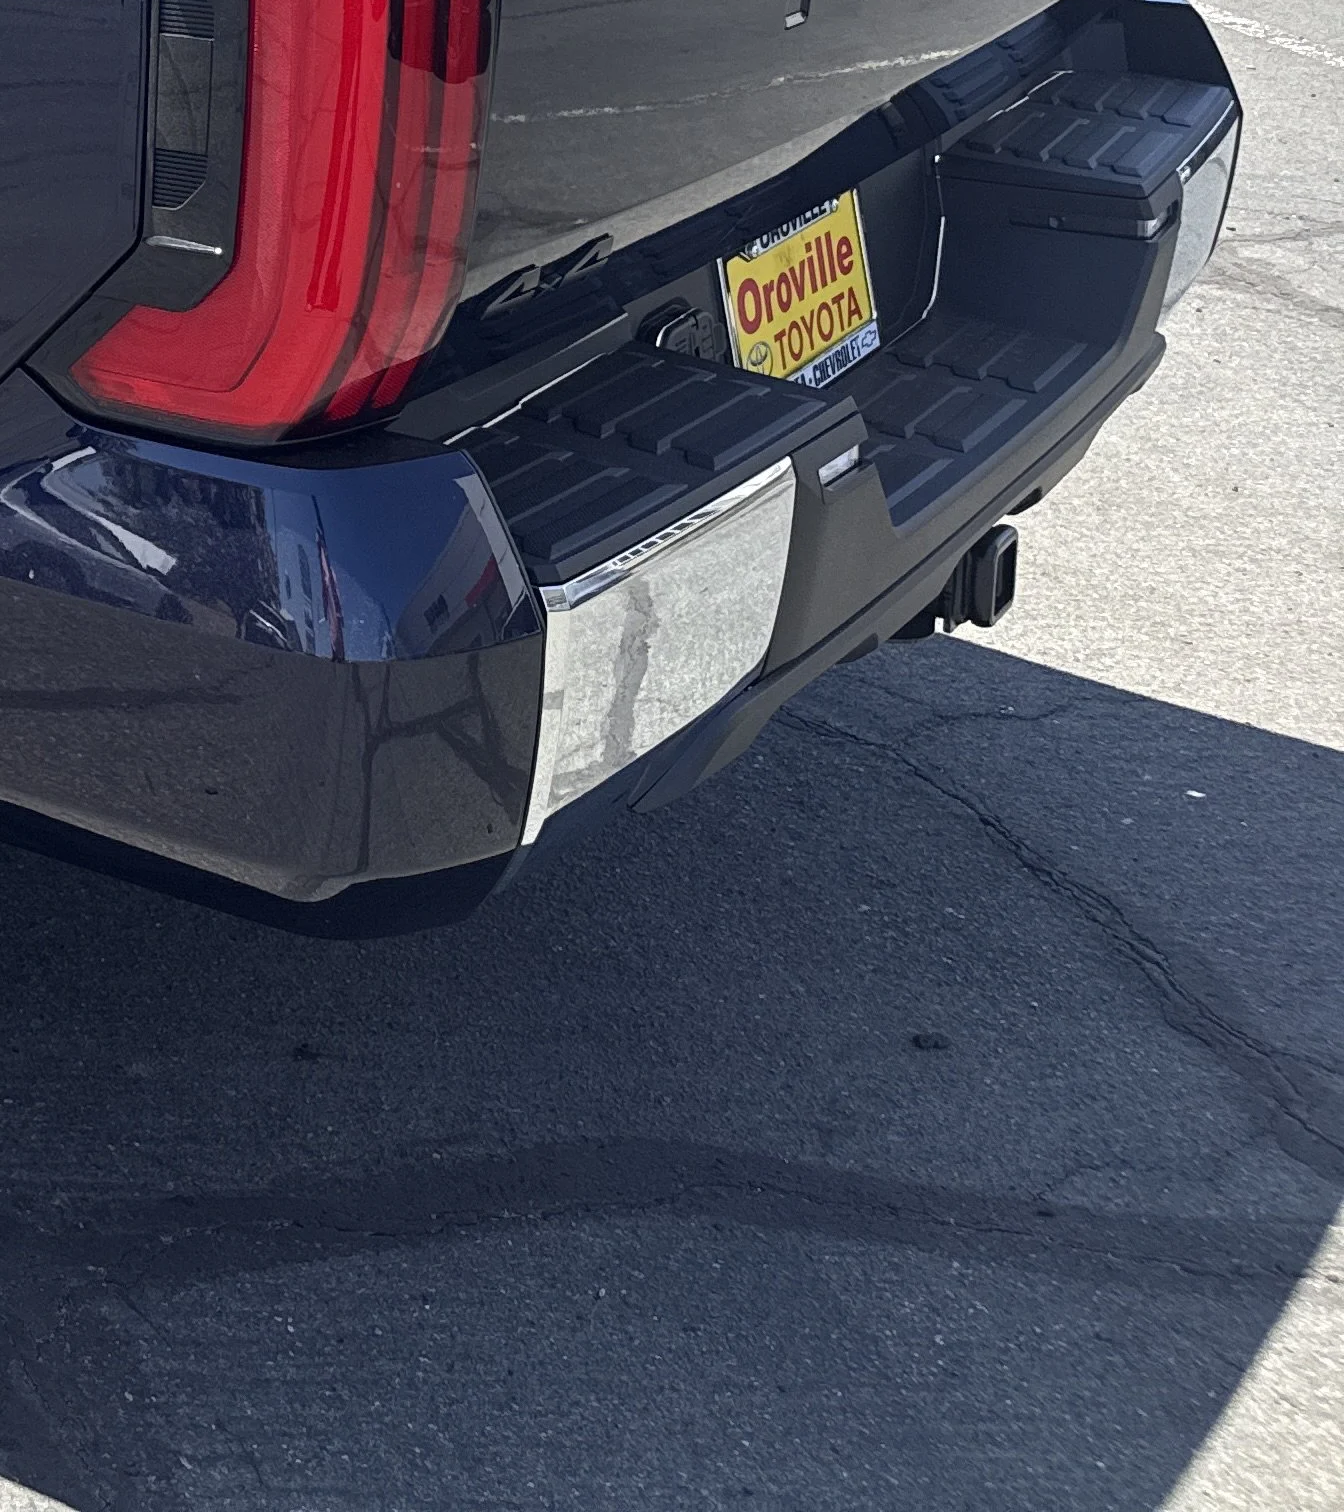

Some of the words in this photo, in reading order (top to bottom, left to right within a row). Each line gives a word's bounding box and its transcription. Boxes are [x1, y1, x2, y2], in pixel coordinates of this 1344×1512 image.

[737, 231, 854, 335] Oroville
[773, 286, 864, 370] TOYOTA
[813, 335, 861, 387] CHEVROLET
